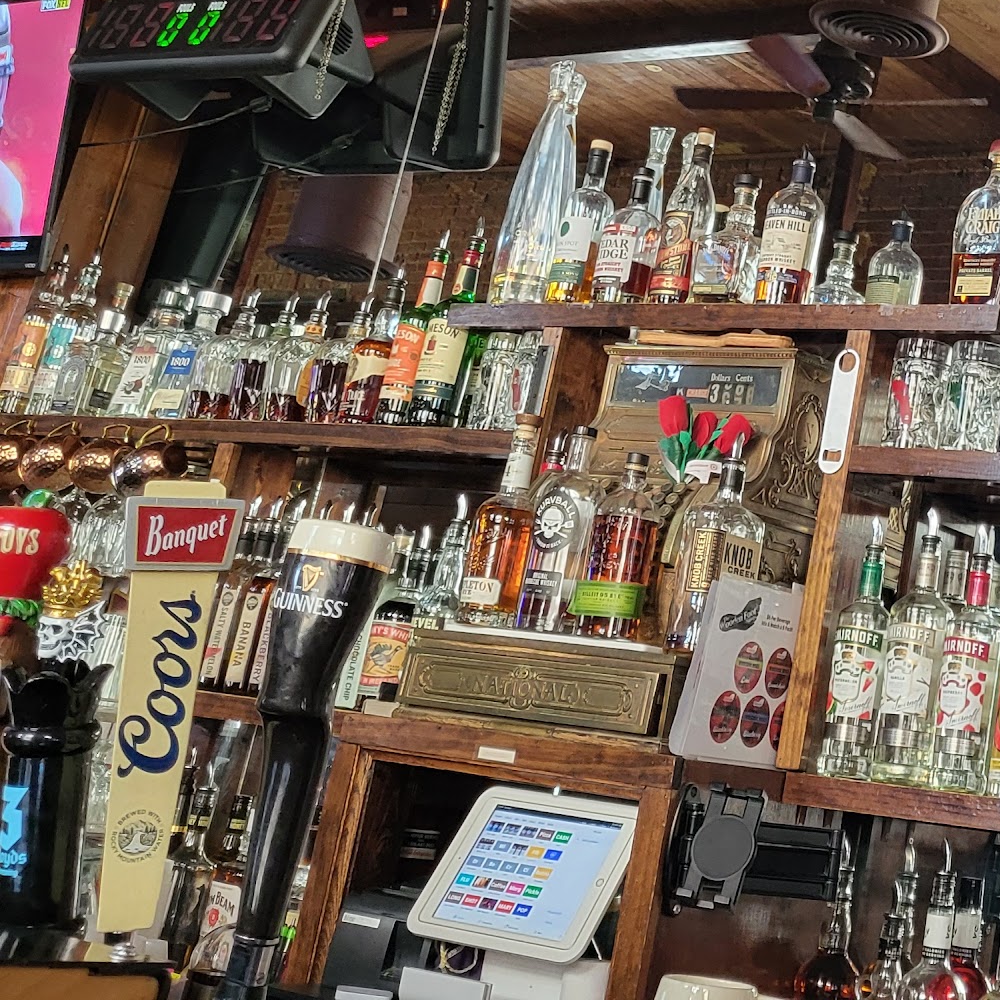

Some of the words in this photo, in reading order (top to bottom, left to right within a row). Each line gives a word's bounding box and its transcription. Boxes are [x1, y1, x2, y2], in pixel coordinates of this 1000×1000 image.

[787, 221, 808, 232] HILL
[964, 220, 1000, 235] CRAIG
[133, 354, 153, 365] 1800
[169, 356, 191, 368] 1800
[710, 372, 731, 383] Dollars
[735, 373, 754, 383] Cents
[536, 495, 577, 520] KURVBALL
[145, 513, 228, 558] Banquet
[695, 531, 707, 562] CREEK
[723, 541, 754, 570] KNOB
[690, 562, 702, 588] KNOB
[727, 565, 756, 580] CREEK
[274, 587, 344, 619] GUINNESS
[217, 606, 229, 629] SALTY
[204, 627, 224, 676] WATEELON
[232, 621, 252, 668] BANANA
[117, 593, 203, 779] Coors
[343, 683, 353, 701] CHIP
[473, 674, 570, 703] NATIONAL
[117, 809, 147, 826] BREWED
[215, 891, 236, 917] BEAM
